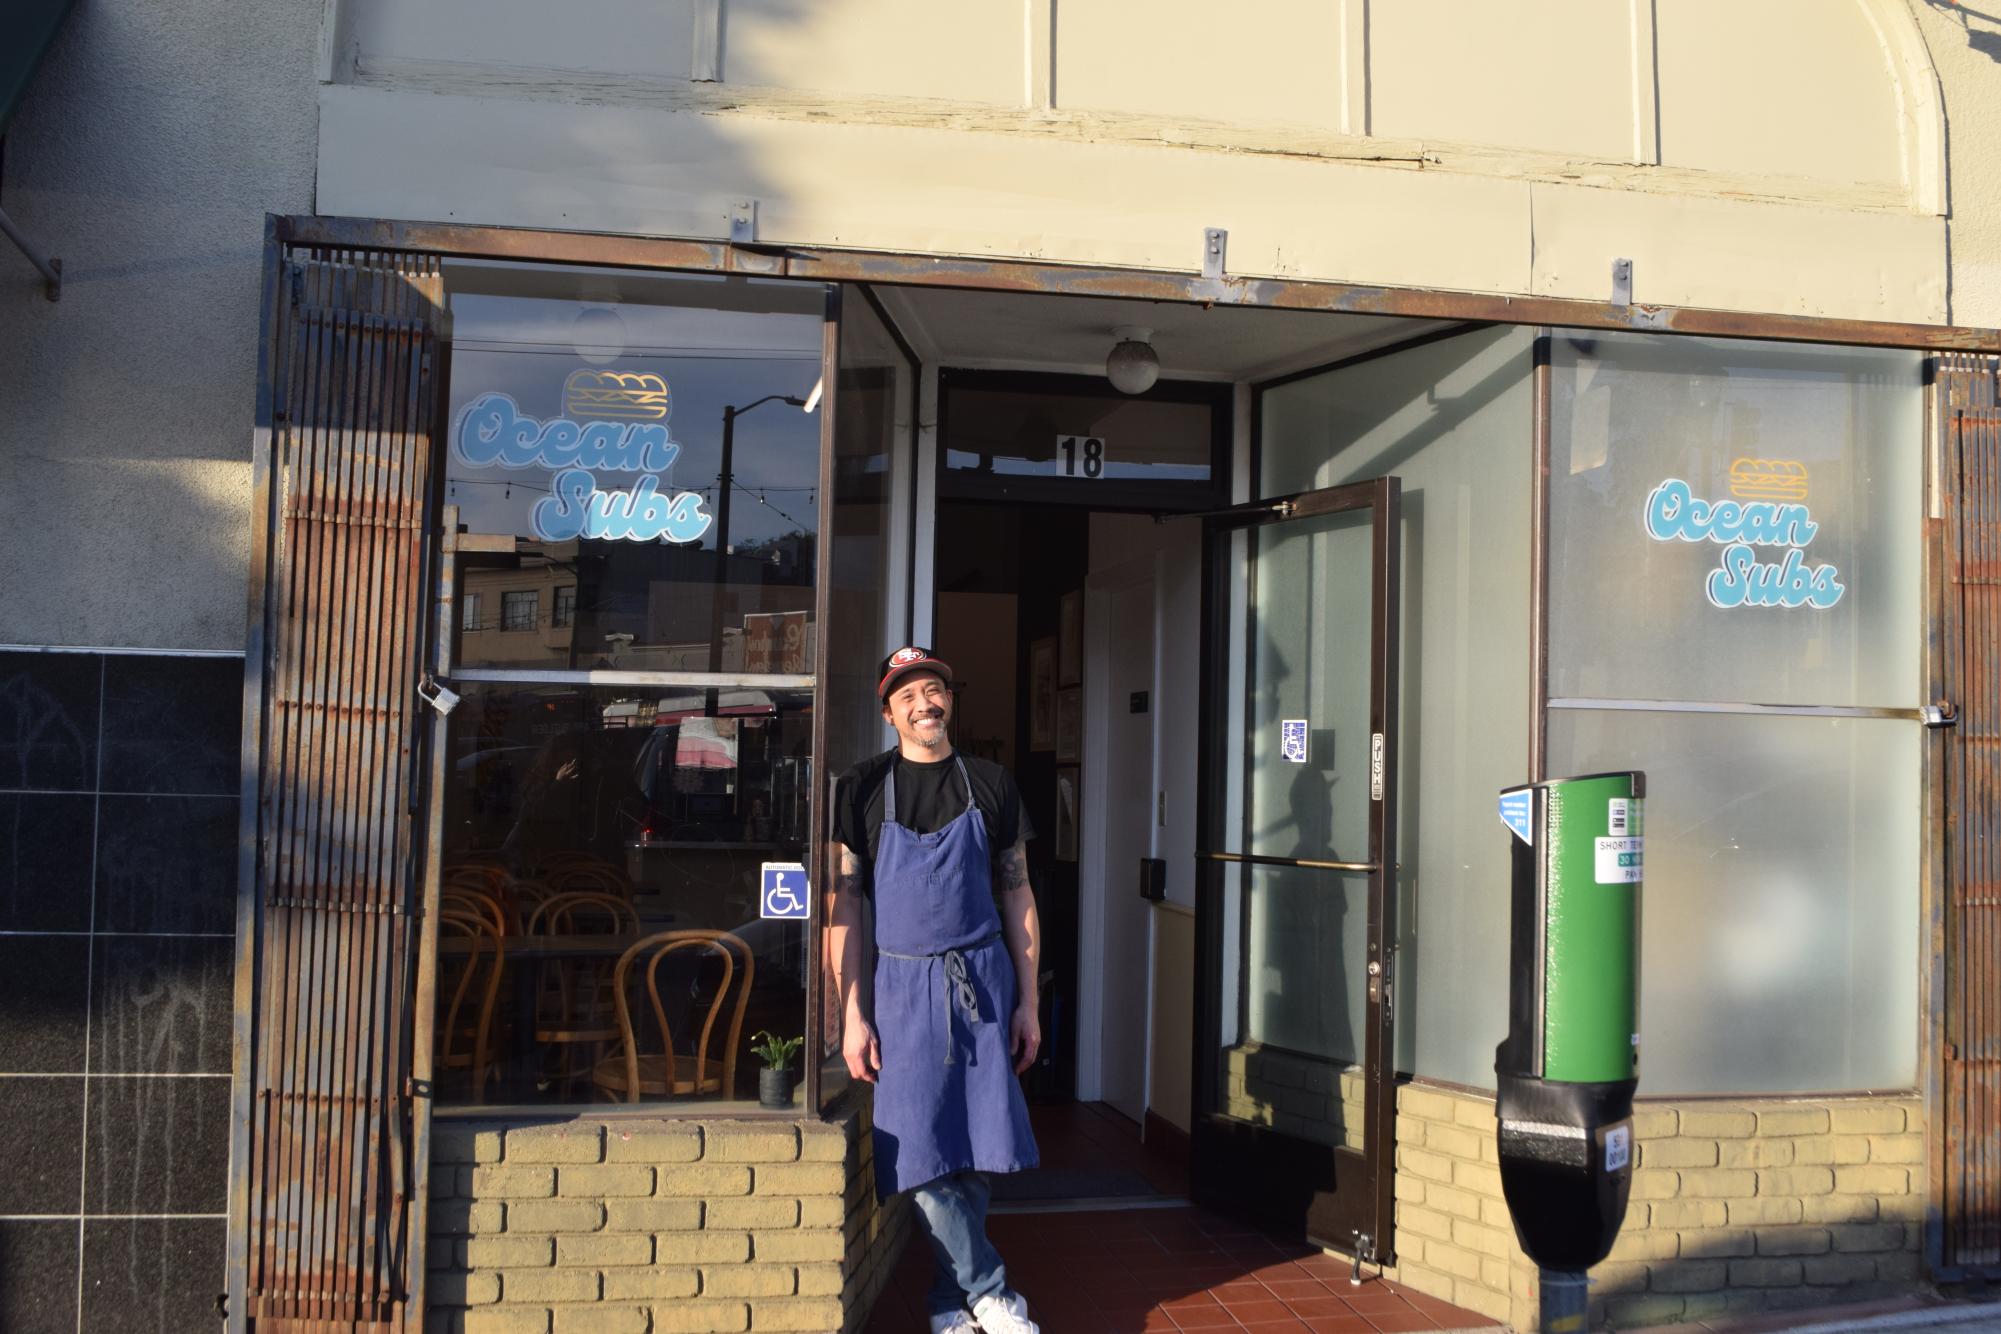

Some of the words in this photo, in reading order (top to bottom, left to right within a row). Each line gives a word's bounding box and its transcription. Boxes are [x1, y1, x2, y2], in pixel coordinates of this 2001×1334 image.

[454, 393, 681, 472] Ocean
[1062, 437, 1102, 477] 18
[531, 470, 712, 542] Subs
[1645, 479, 1818, 547] Ocean
[1706, 544, 1845, 609] Subs
[1374, 739, 1382, 784] PUSH
[1600, 841, 1627, 850] SHORT
[1619, 855, 1630, 865] 30
